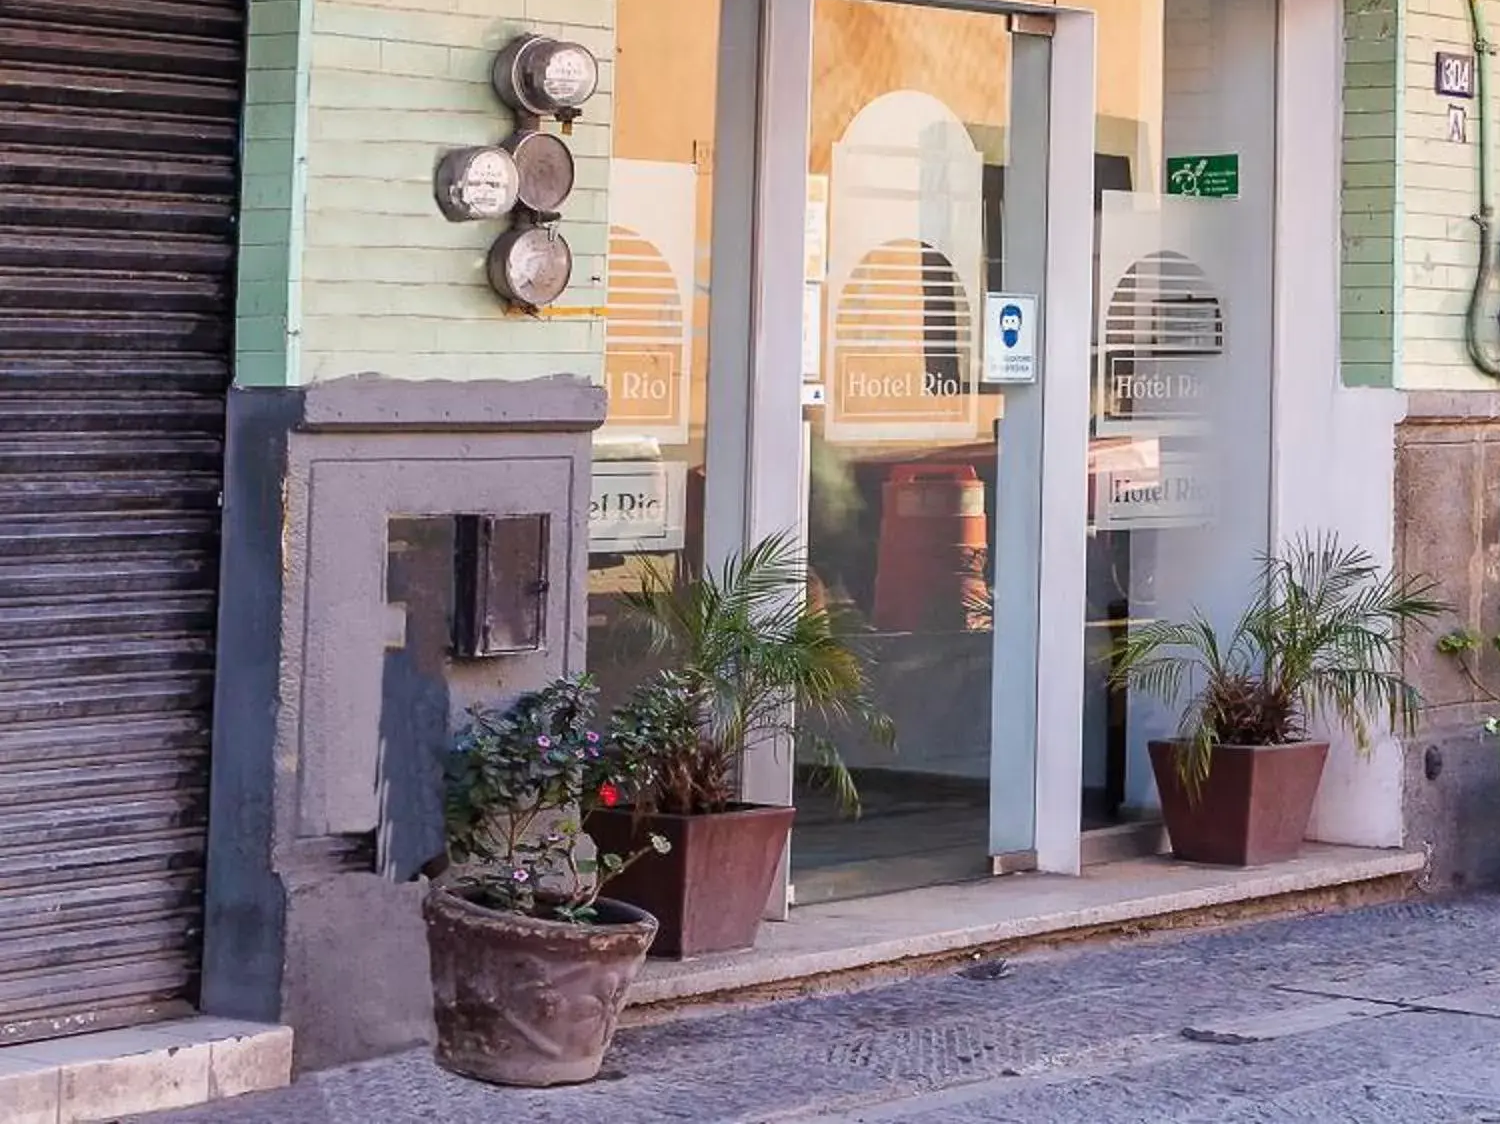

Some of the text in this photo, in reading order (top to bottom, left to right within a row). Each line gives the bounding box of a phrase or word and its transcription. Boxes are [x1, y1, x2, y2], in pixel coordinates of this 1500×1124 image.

[622, 371, 667, 400] Rio
[849, 372, 959, 398] Hotel Rio
[1116, 373, 1210, 399] Hotel Ri
